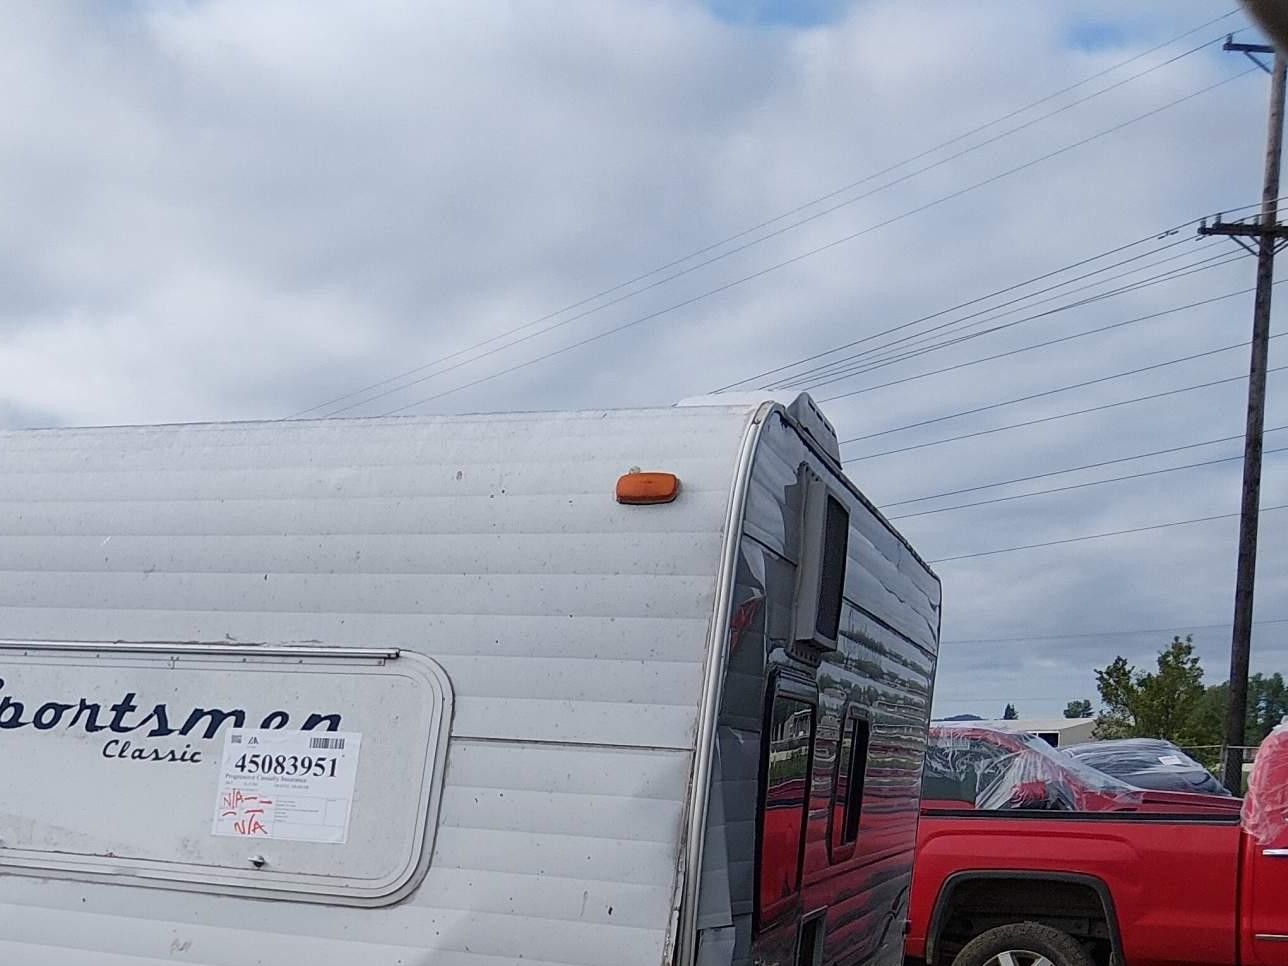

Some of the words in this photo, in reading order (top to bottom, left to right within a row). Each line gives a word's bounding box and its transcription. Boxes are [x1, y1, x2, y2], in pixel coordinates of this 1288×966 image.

[102, 738, 202, 764] Classic
[234, 753, 337, 778] 45083951
[234, 814, 268, 835] N/A
